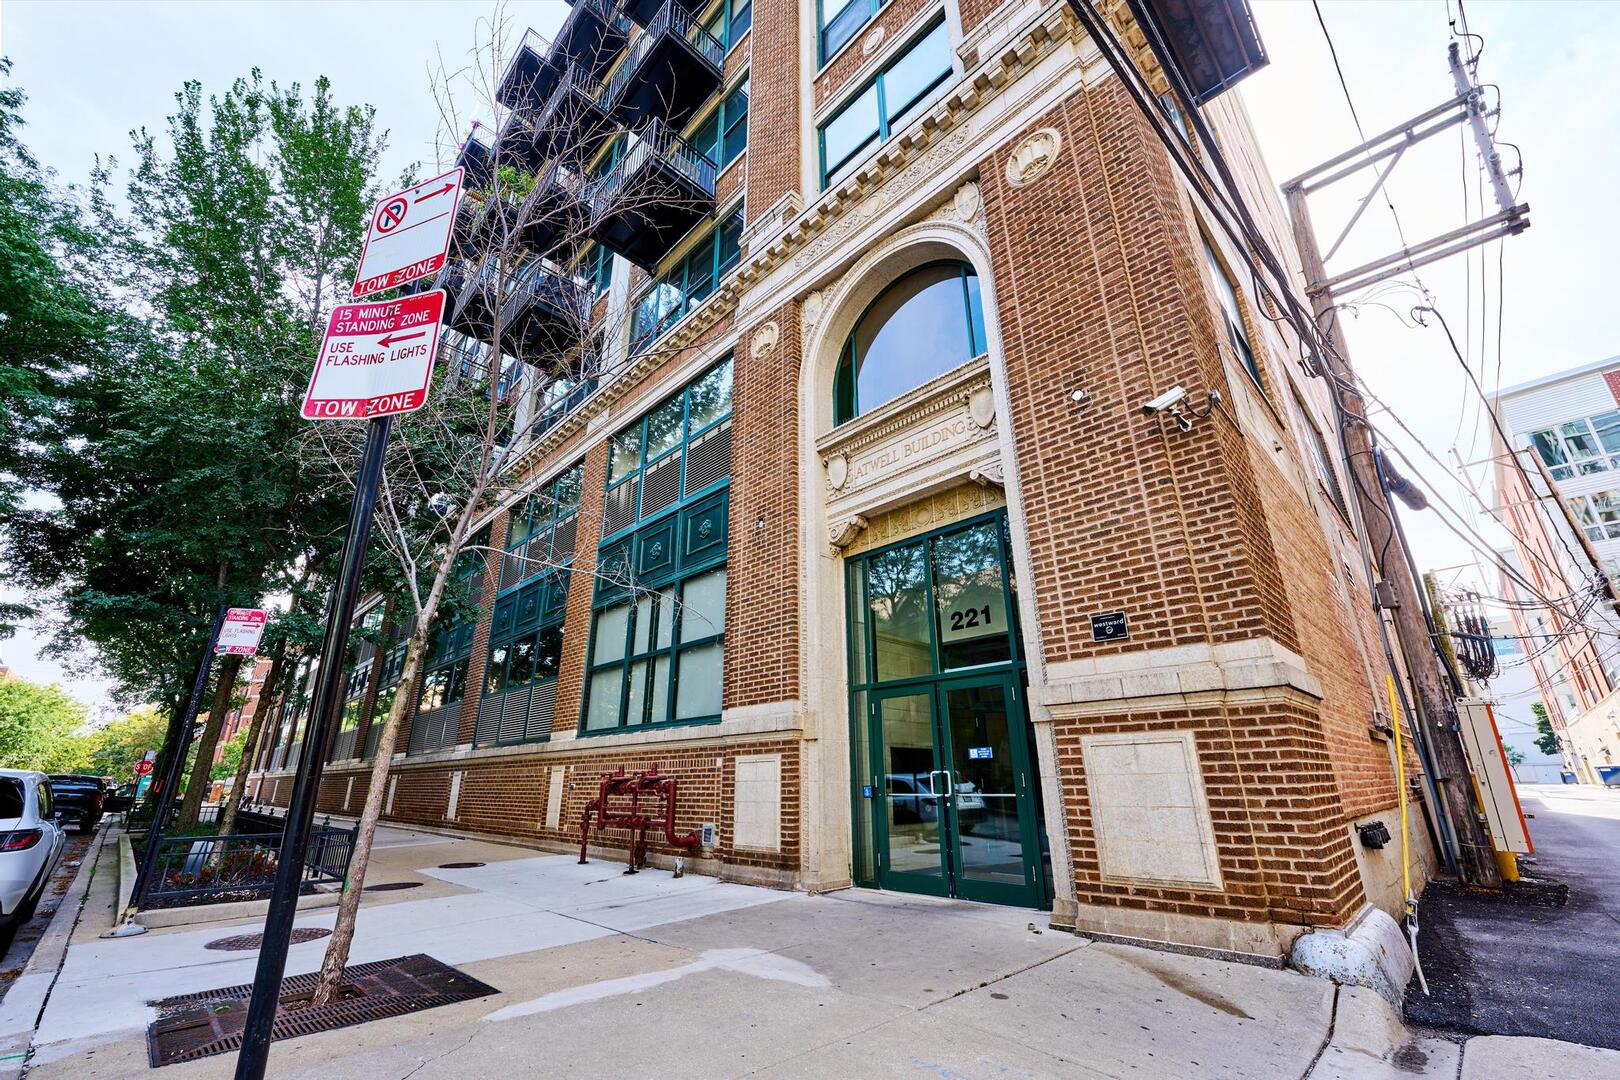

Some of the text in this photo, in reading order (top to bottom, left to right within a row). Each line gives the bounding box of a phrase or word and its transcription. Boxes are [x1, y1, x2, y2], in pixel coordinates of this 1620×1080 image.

[360, 257, 437, 294] TOW ZONE
[335, 310, 430, 333] STANDING ZONE
[339, 304, 402, 320] 15 MINUTE
[326, 344, 427, 366] FLASHING LIGHTS
[330, 342, 354, 353] USE
[314, 393, 415, 416] TOW ZONE
[856, 420, 966, 479] ATWELL BUILDING
[950, 605, 991, 631] 221
